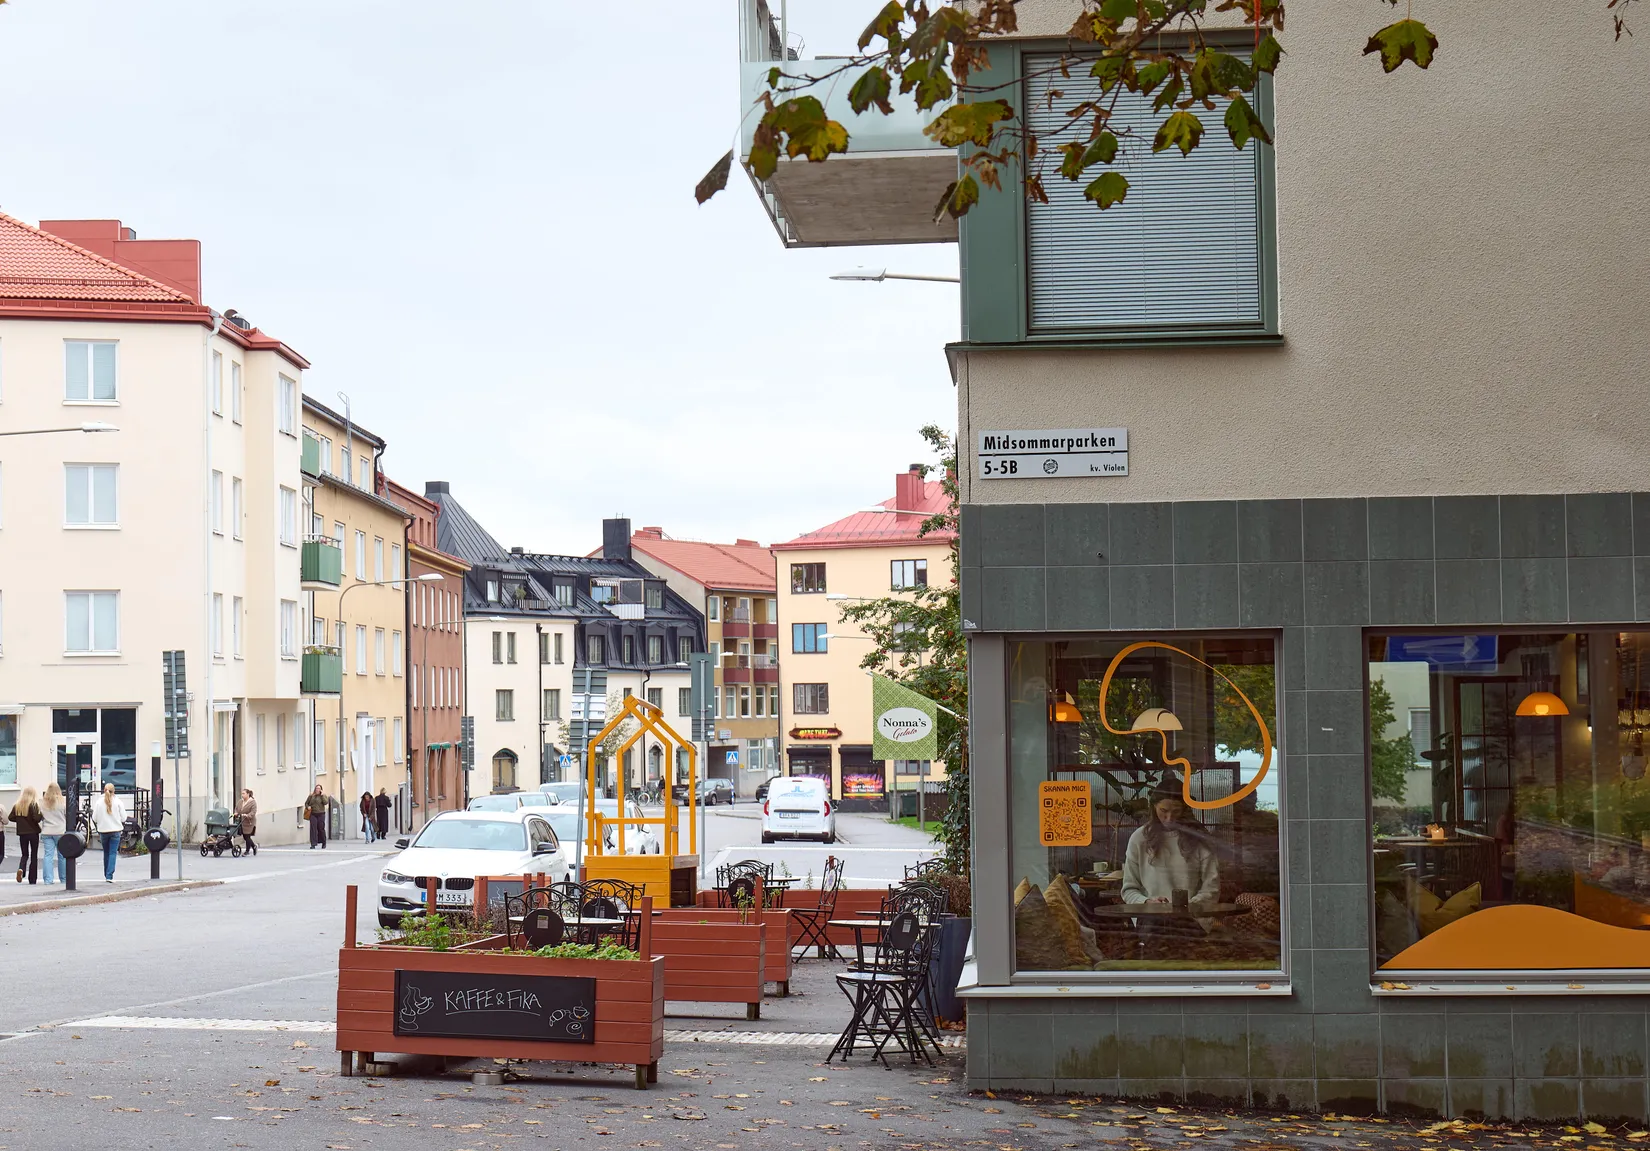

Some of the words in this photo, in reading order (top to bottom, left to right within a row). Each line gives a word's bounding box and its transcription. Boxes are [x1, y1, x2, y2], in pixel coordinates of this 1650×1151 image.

[984, 433, 1116, 451] Midsommarparken
[984, 460, 1018, 475] 5-5B
[1090, 464, 1101, 472] kv.
[1103, 463, 1126, 472] Violen
[883, 718, 927, 727] Nonna's
[893, 728, 918, 740] Gelato
[1043, 785, 1071, 793] SKANNA
[445, 893, 462, 902] 333
[444, 988, 495, 1011] KAFFE
[506, 989, 542, 1010] FIKA
